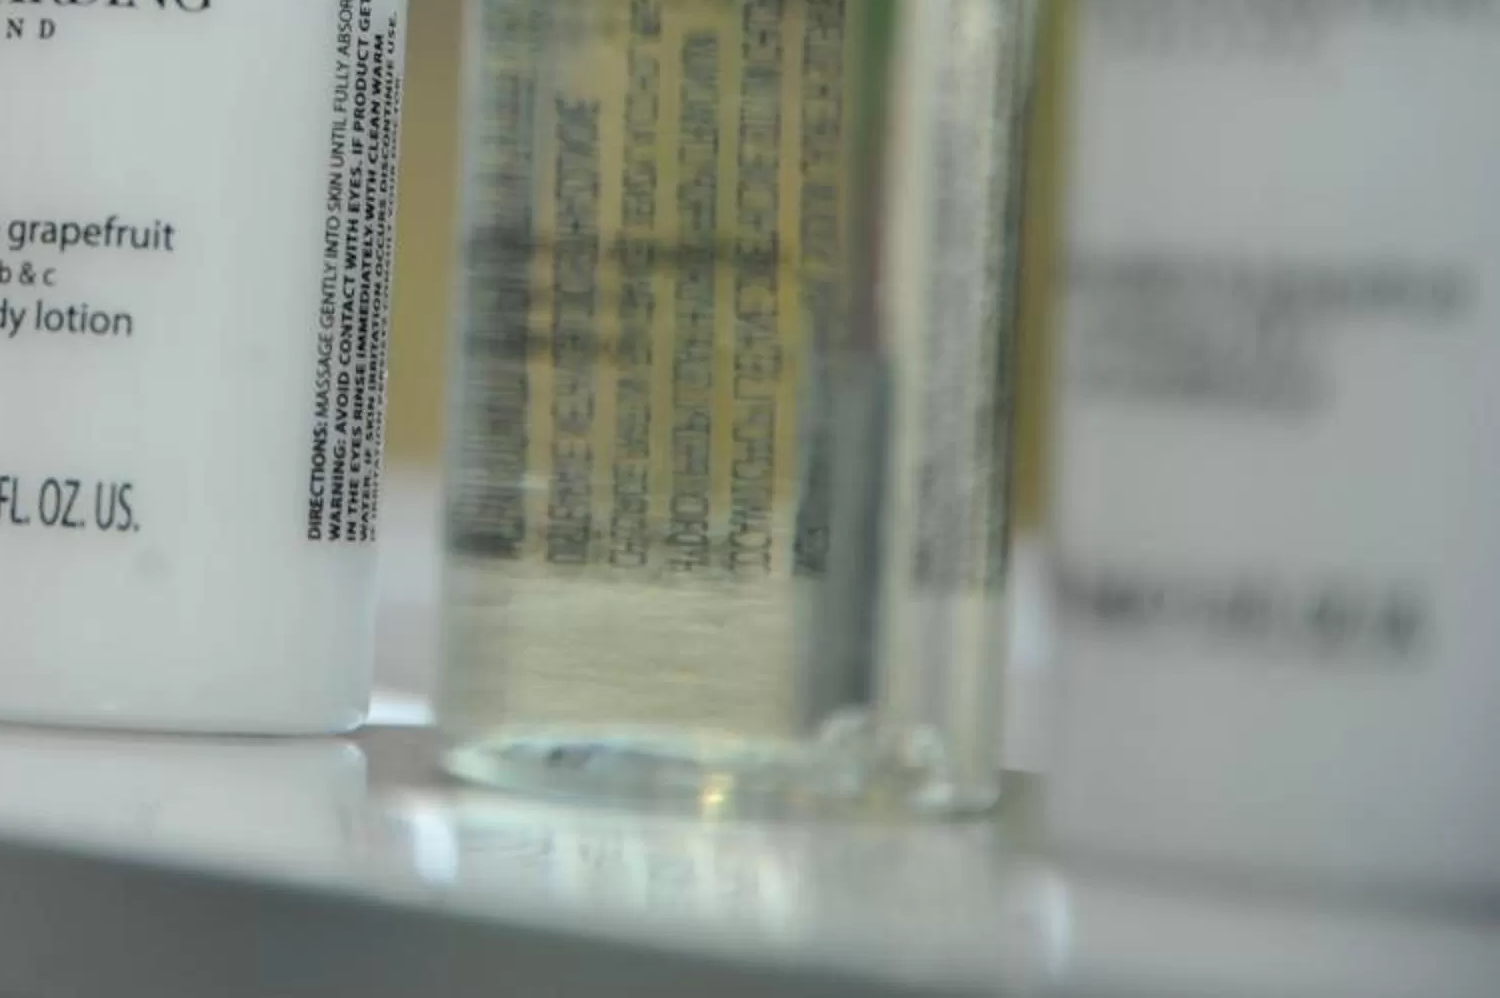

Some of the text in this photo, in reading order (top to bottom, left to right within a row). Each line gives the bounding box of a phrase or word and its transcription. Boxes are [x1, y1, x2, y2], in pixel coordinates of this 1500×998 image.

[333, 60, 350, 113] FULLY
[352, 36, 369, 133] PRODUCT
[329, 118, 347, 168] UNTIL
[351, 136, 363, 155] IF
[327, 172, 343, 212] SKIN
[347, 159, 363, 214] EYES.
[8, 214, 175, 253] grapefruit
[324, 215, 341, 259] INTO
[344, 219, 358, 270] WITH
[19, 260, 37, 286] &
[42, 266, 57, 287] c
[319, 261, 337, 330] GENTLY
[347, 33, 384, 542] IN THE EYES RINSE IMMEDIATELY WITH CLEAN WARM
[34, 299, 134, 337] lotion
[338, 275, 356, 366] CONTACT
[314, 333, 333, 419] MASSAGE
[334, 371, 350, 435] AVOID
[38, 476, 86, 529] OZ.
[94, 480, 142, 534] US.
[307, 421, 328, 541] DIRECTIONS:
[328, 439, 346, 542] WARNING:
